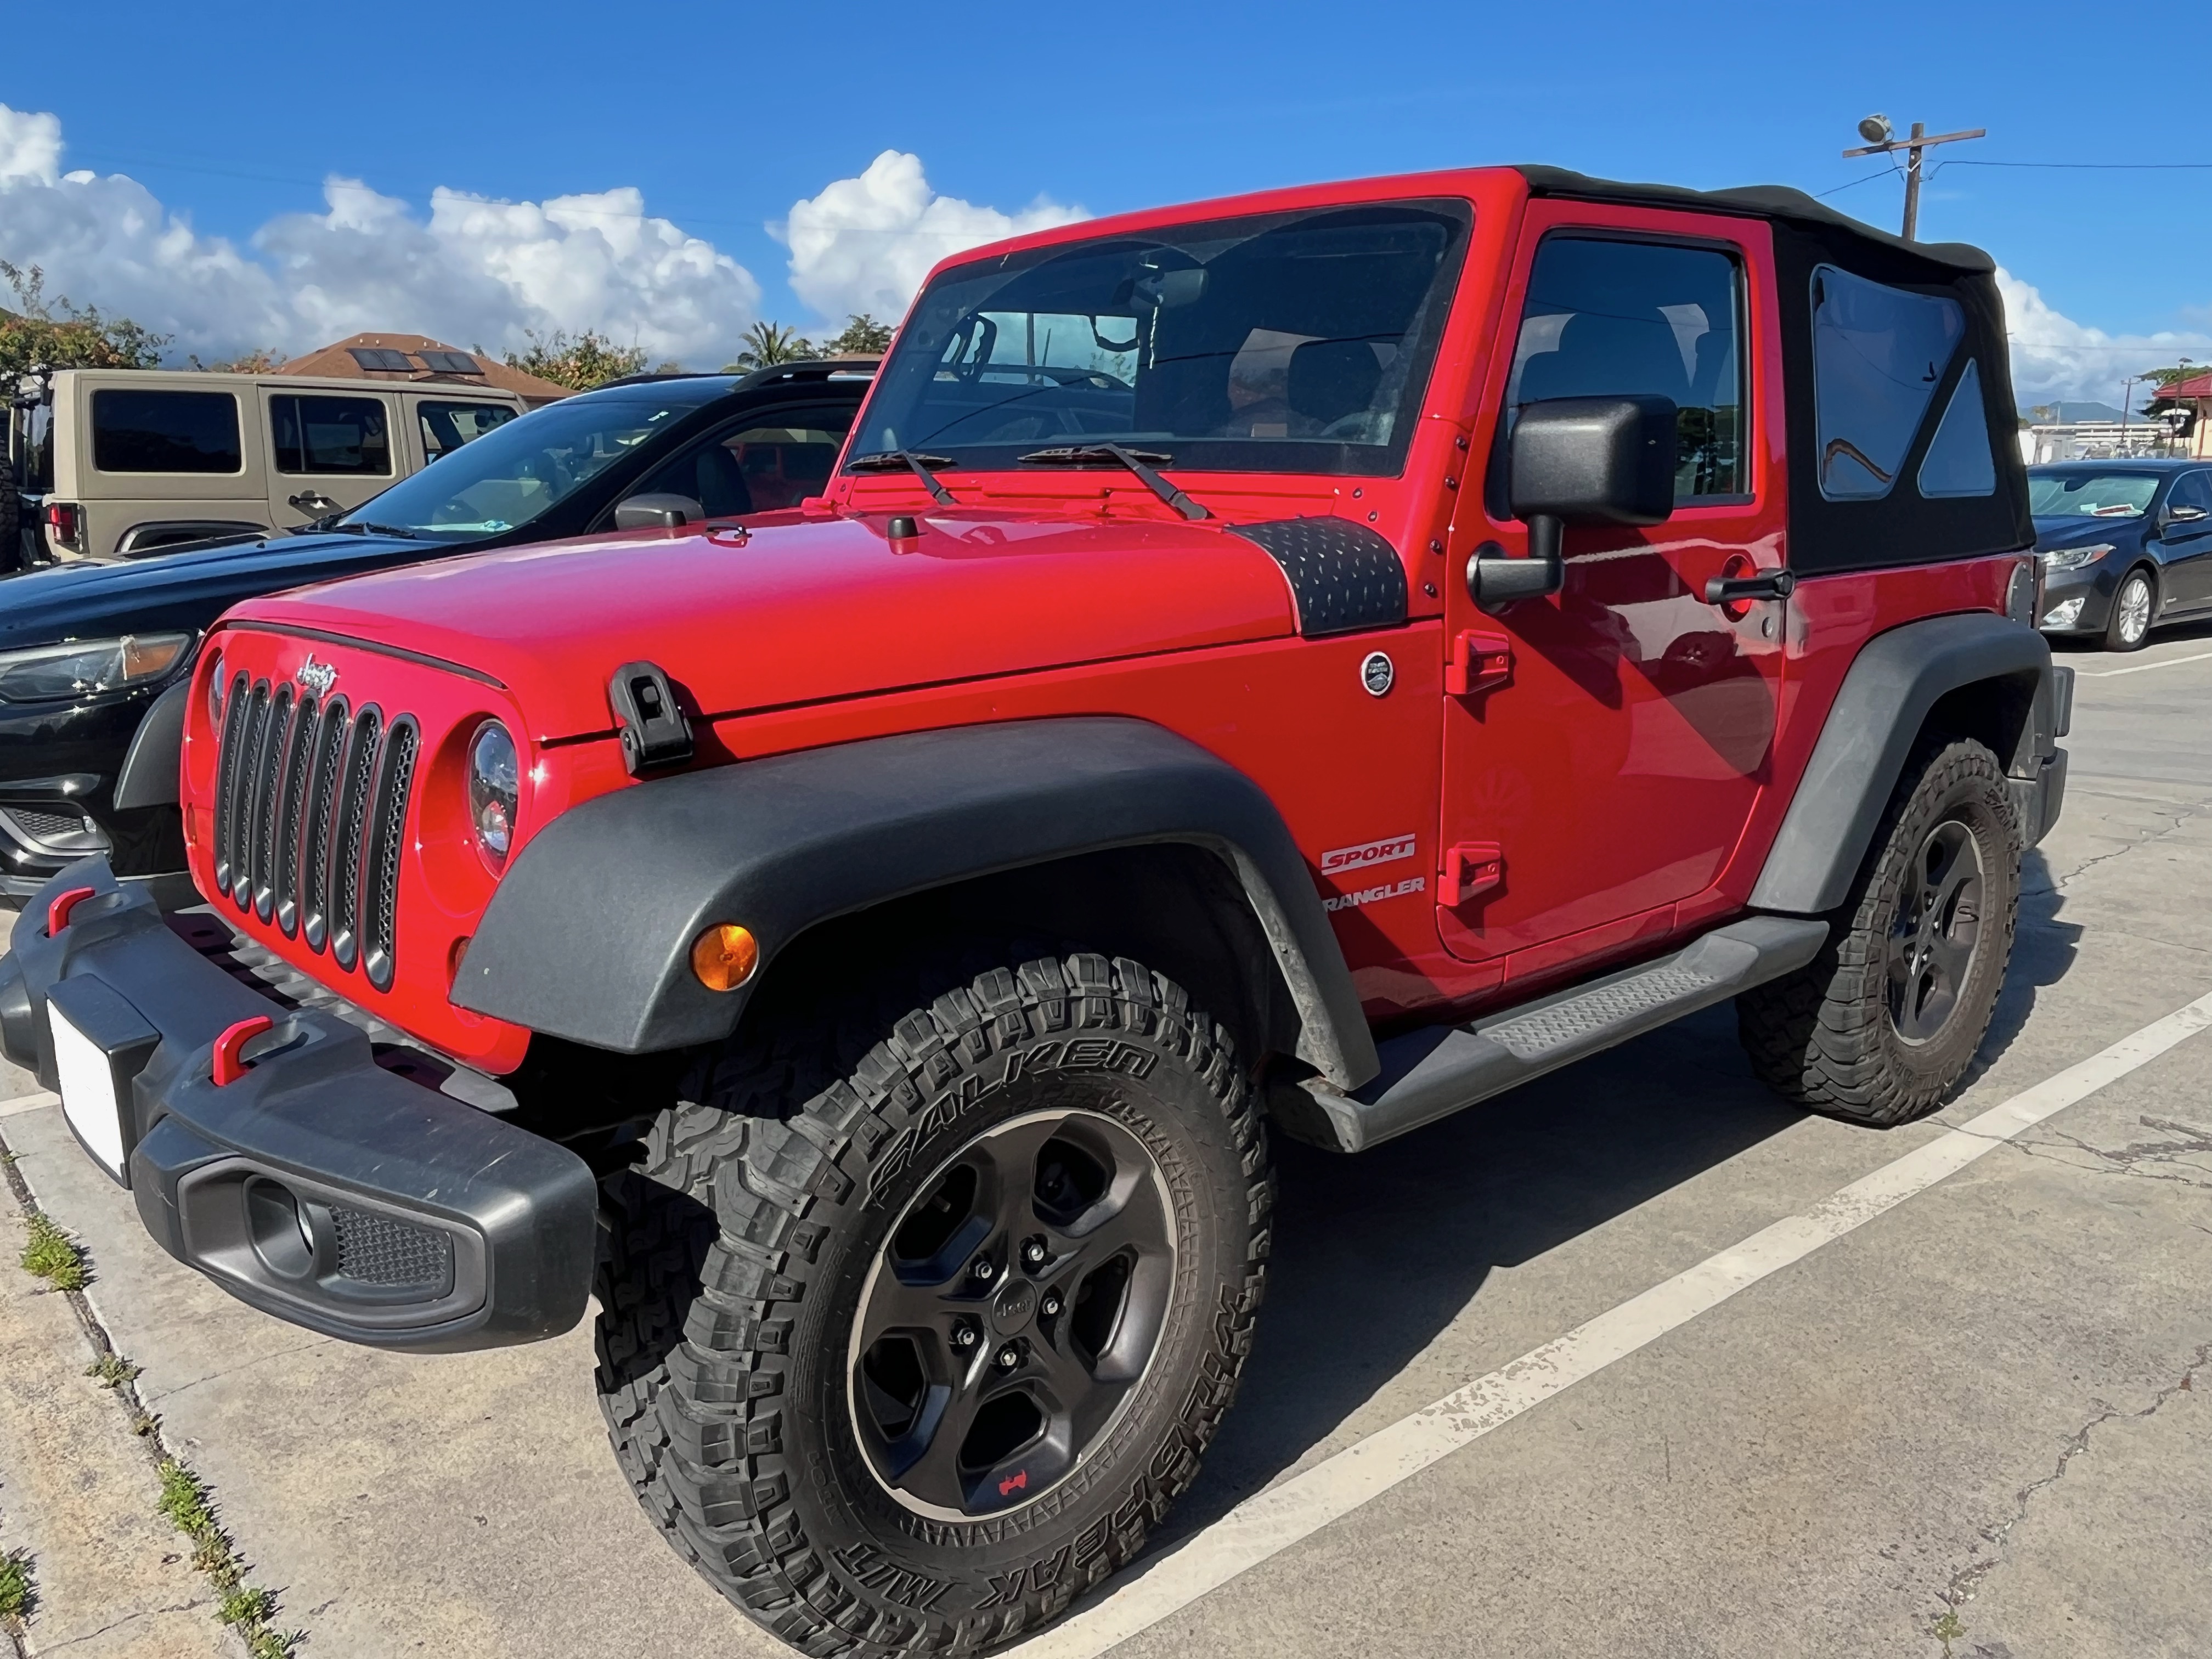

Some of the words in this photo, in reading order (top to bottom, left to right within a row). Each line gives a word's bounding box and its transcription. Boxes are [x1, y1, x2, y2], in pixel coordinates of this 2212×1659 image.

[1324, 839, 1414, 869] SPORT
[1321, 877, 1425, 913] RANGLER
[859, 1036, 1160, 1212] FALKEN
